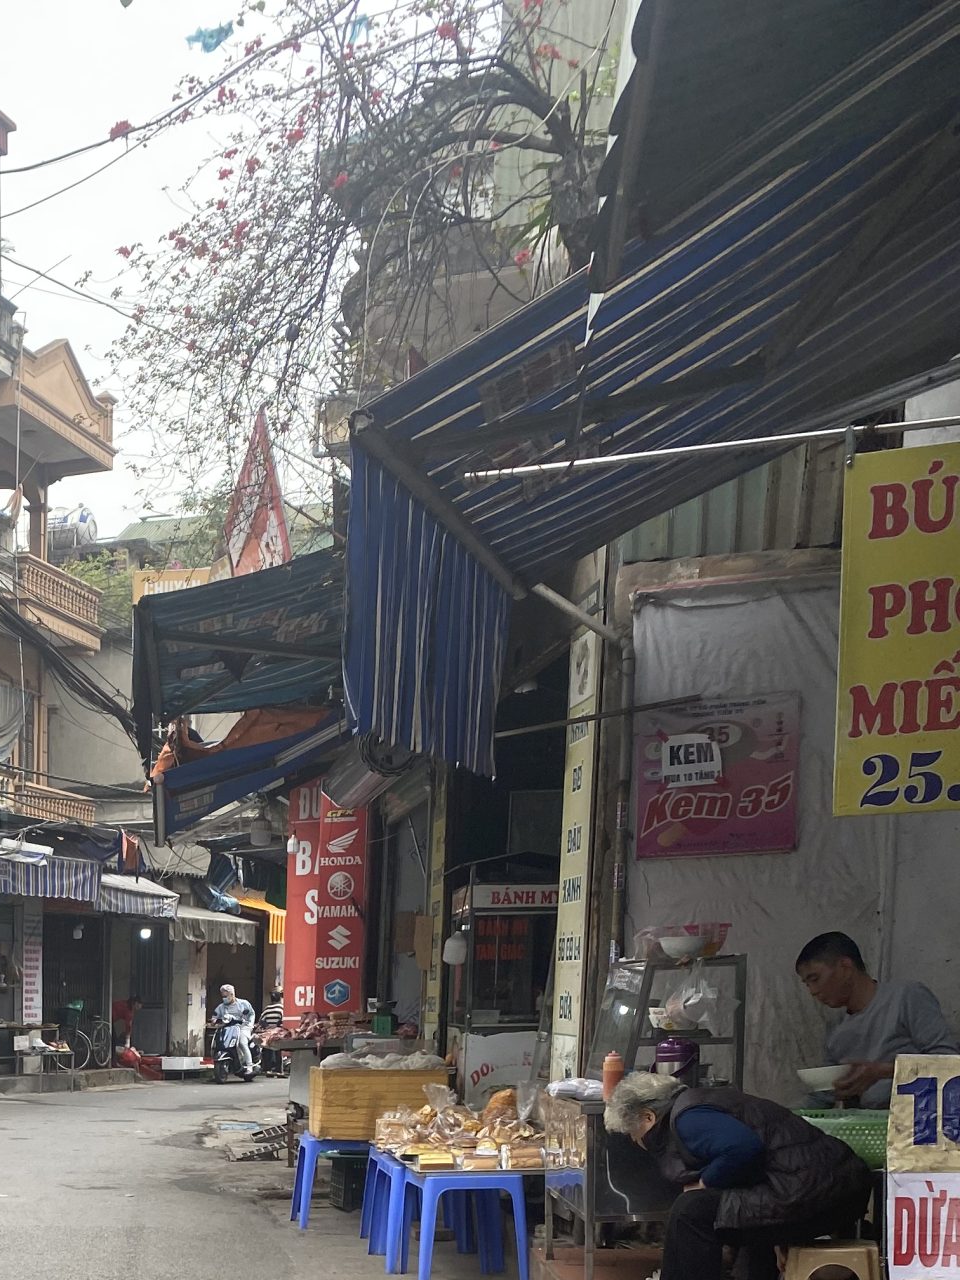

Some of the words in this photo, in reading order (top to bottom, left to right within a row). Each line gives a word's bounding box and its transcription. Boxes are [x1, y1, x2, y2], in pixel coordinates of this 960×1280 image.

[867, 578, 960, 638] PH
[669, 742, 715, 766] KEM
[640, 788, 733, 839] Kem
[736, 771, 795, 819] 35
[320, 856, 363, 866] HONDA
[490, 886, 537, 905] BÁNH
[315, 956, 360, 969] SUZUKI
